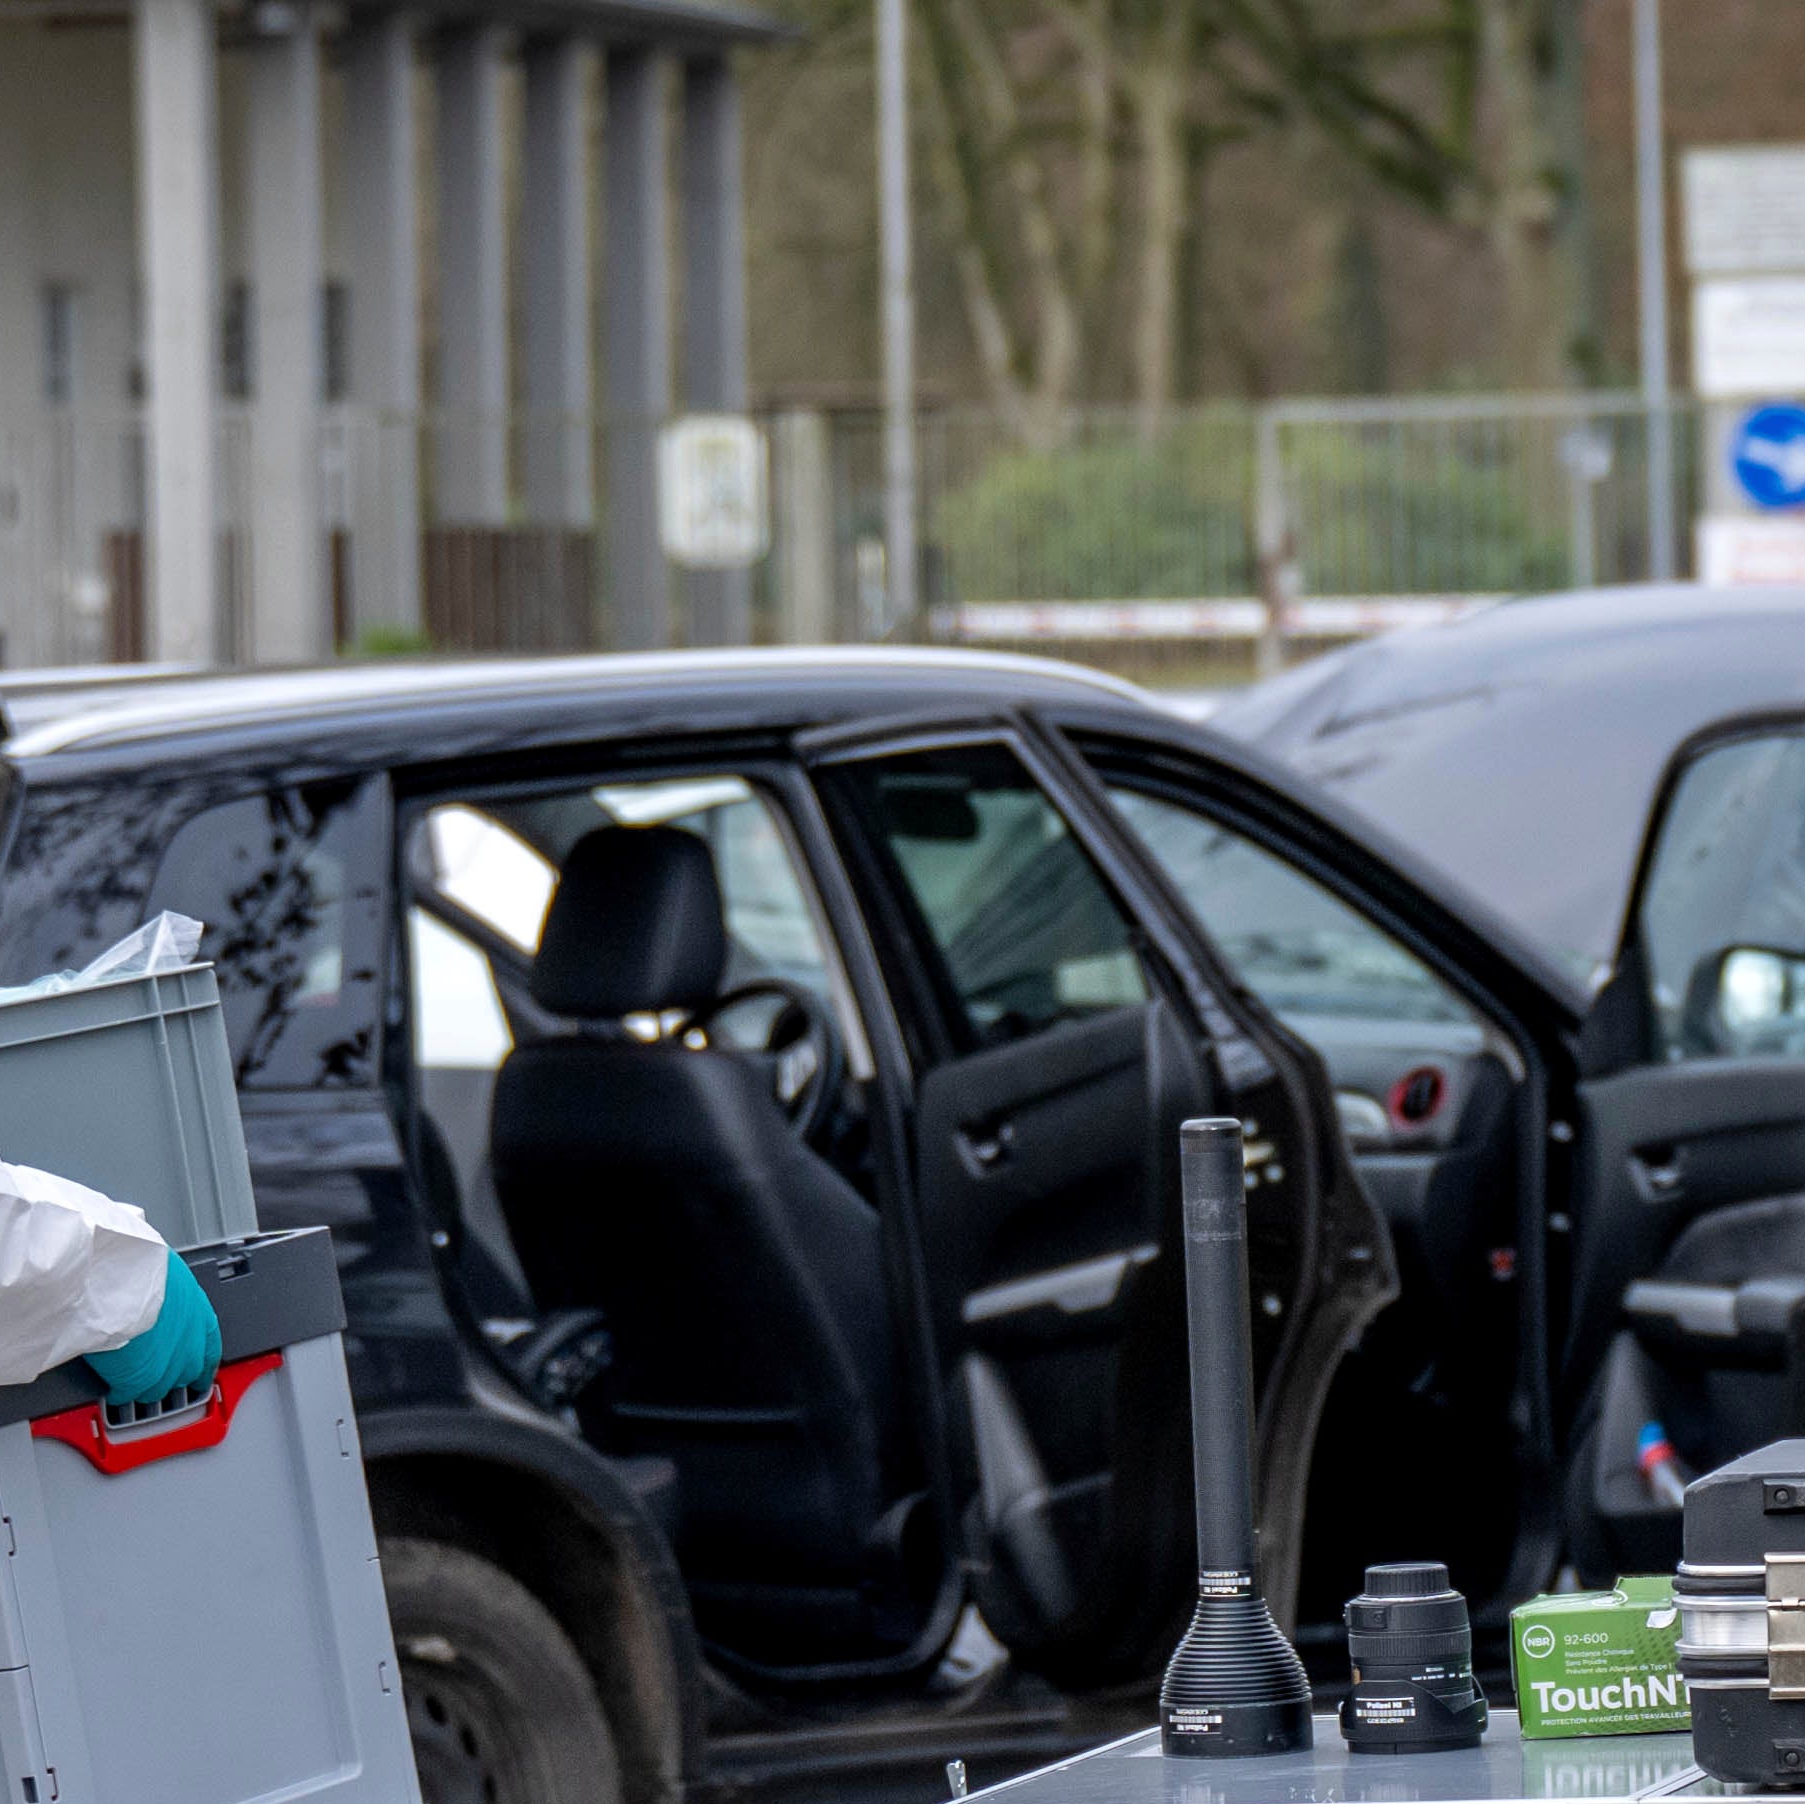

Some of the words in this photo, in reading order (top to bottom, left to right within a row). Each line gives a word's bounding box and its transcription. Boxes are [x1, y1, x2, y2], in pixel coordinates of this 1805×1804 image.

[1527, 1637, 1550, 1647] NBR
[1563, 1633, 1609, 1646] 92-600
[1650, 1663, 1669, 1671] Type
[1540, 1717, 1587, 1727] PROTECTION
